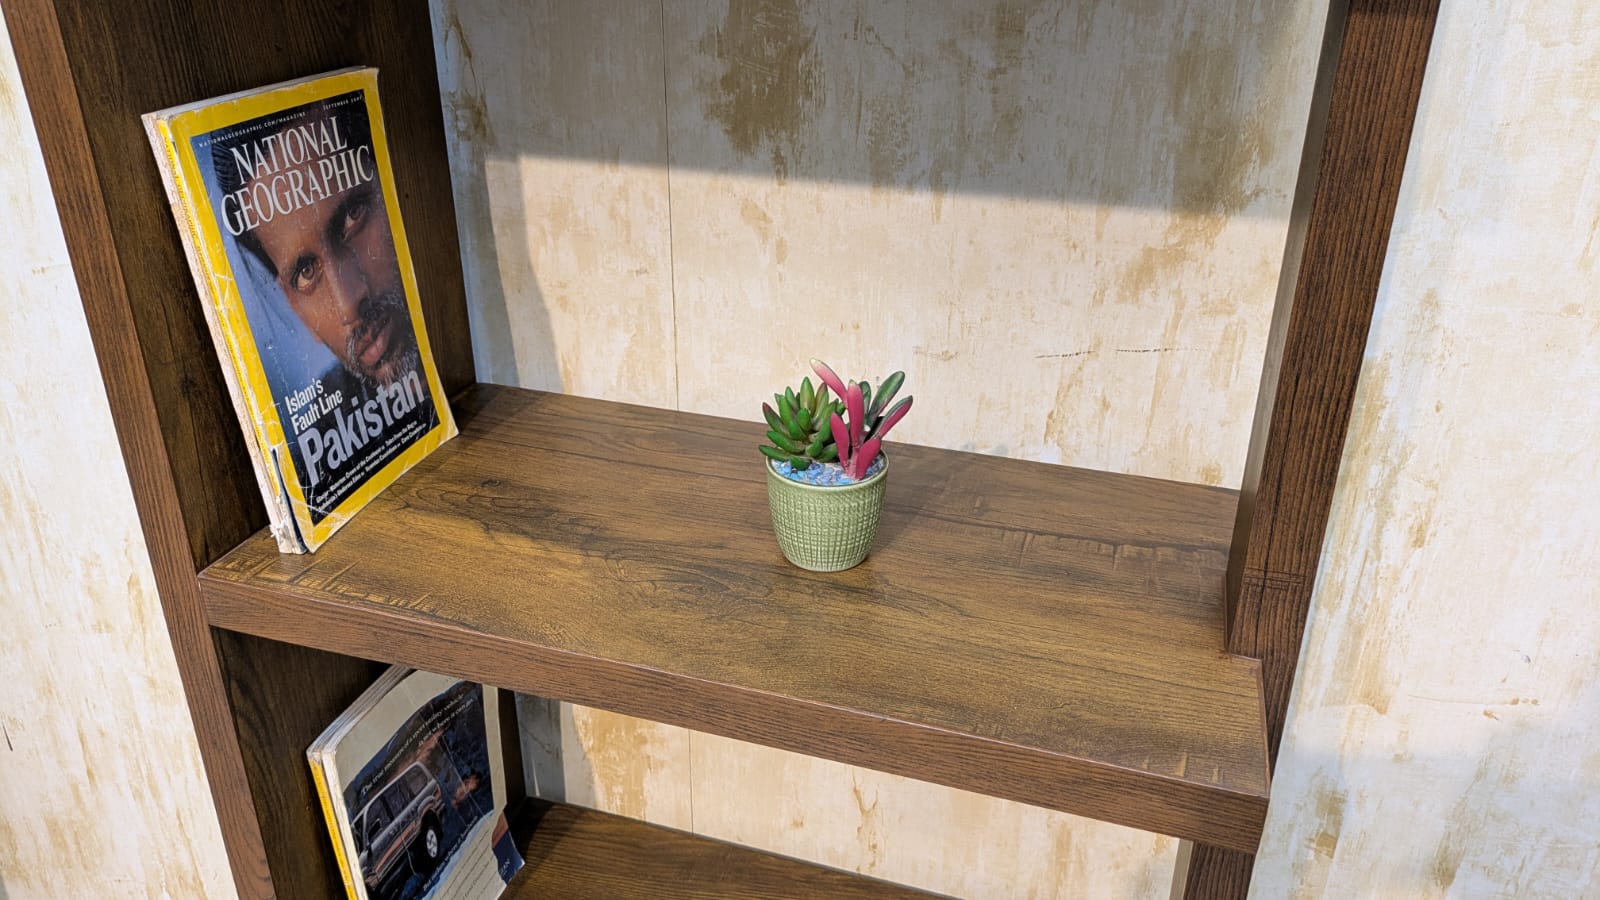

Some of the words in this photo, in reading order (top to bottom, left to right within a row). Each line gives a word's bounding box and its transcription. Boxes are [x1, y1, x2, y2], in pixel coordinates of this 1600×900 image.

[230, 116, 348, 185] NATIONAL
[221, 145, 374, 236] GEOGRAPHIC
[285, 378, 324, 415] Islam's
[291, 404, 321, 435] Fault
[318, 389, 343, 415] Line
[297, 370, 425, 487] Pakistan
